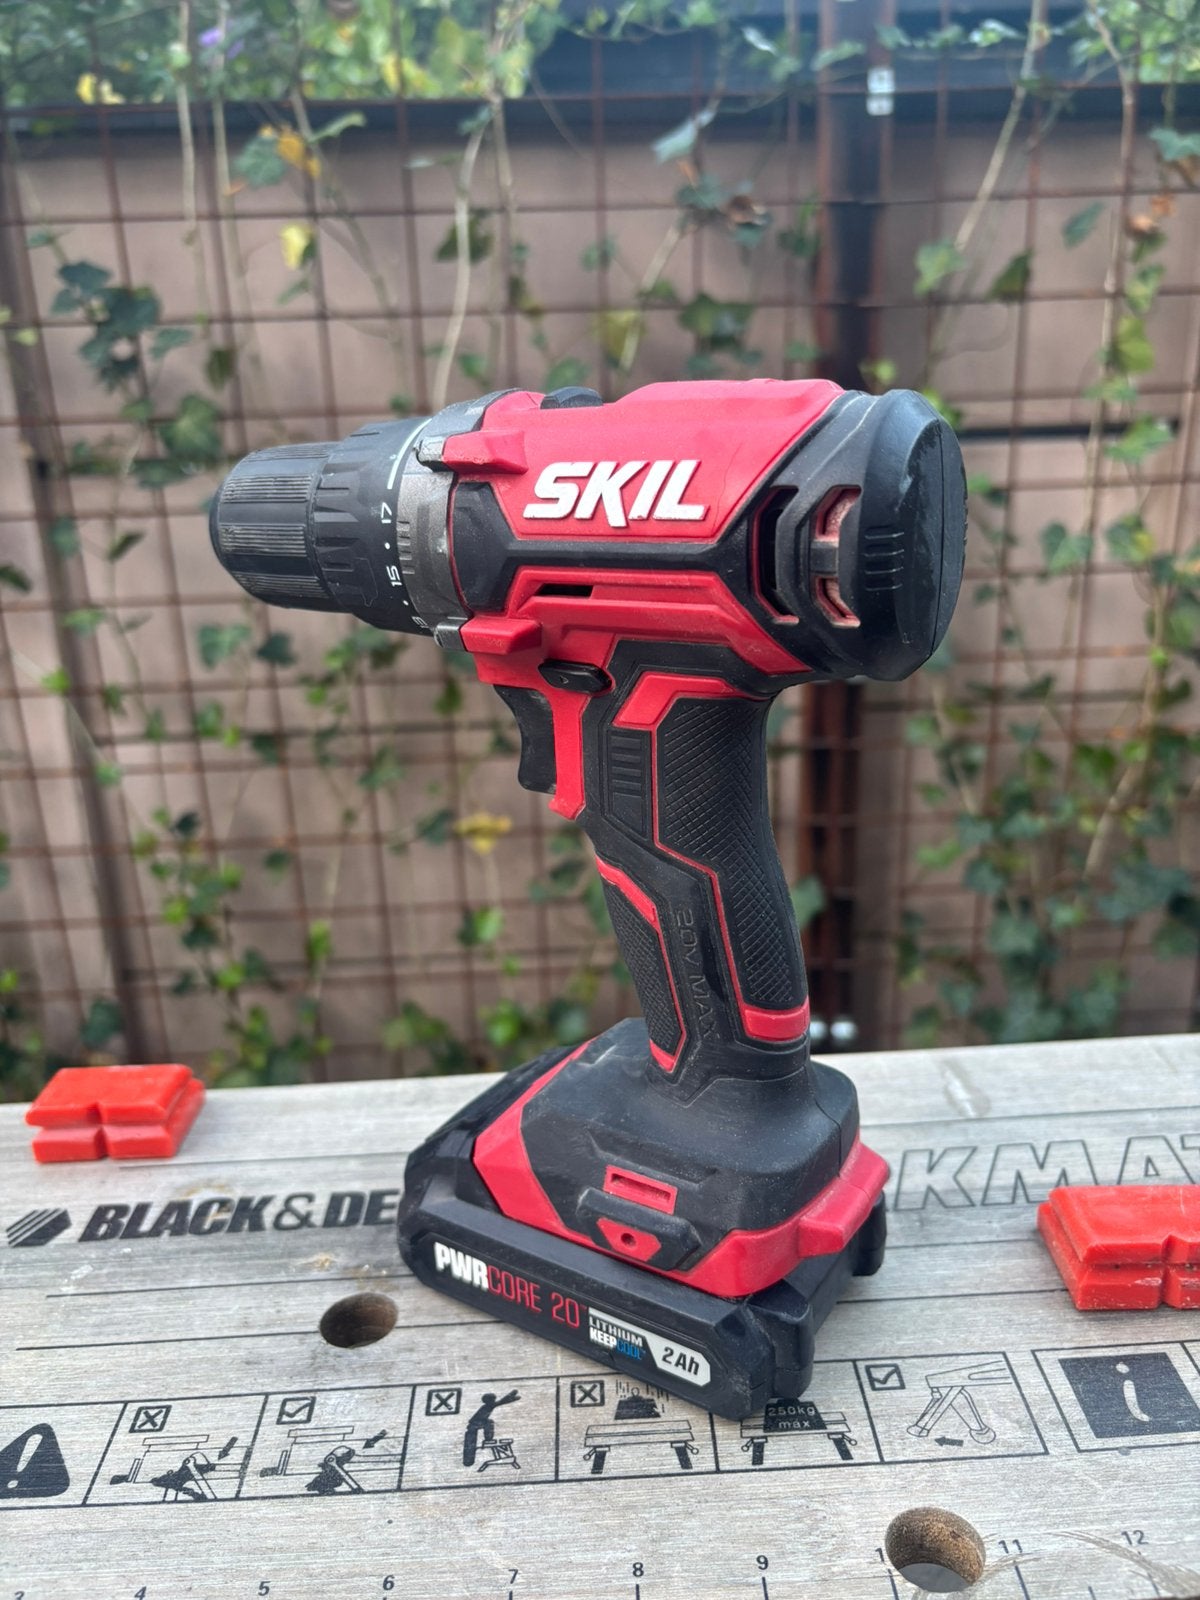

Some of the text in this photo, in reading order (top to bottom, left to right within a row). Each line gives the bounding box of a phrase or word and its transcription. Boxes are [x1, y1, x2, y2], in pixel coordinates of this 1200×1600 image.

[522, 459, 706, 527] SKIL
[380, 502, 392, 523] 17
[386, 565, 402, 587] 15
[676, 909, 699, 966] 20V
[434, 1241, 542, 1313] PWRCORE
[589, 1315, 643, 1348] LITHIUM
[768, 1406, 816, 1417] 250kg
[779, 1420, 811, 1430] max
[134, 1586, 147, 1600] 4
[258, 1581, 271, 1596] 5
[382, 1574, 395, 1591] 6
[508, 1568, 519, 1584] 7
[632, 1562, 645, 1578] 8
[756, 1554, 769, 1571] 9
[998, 1539, 1023, 1554] 11
[1121, 1529, 1148, 1546] 12
